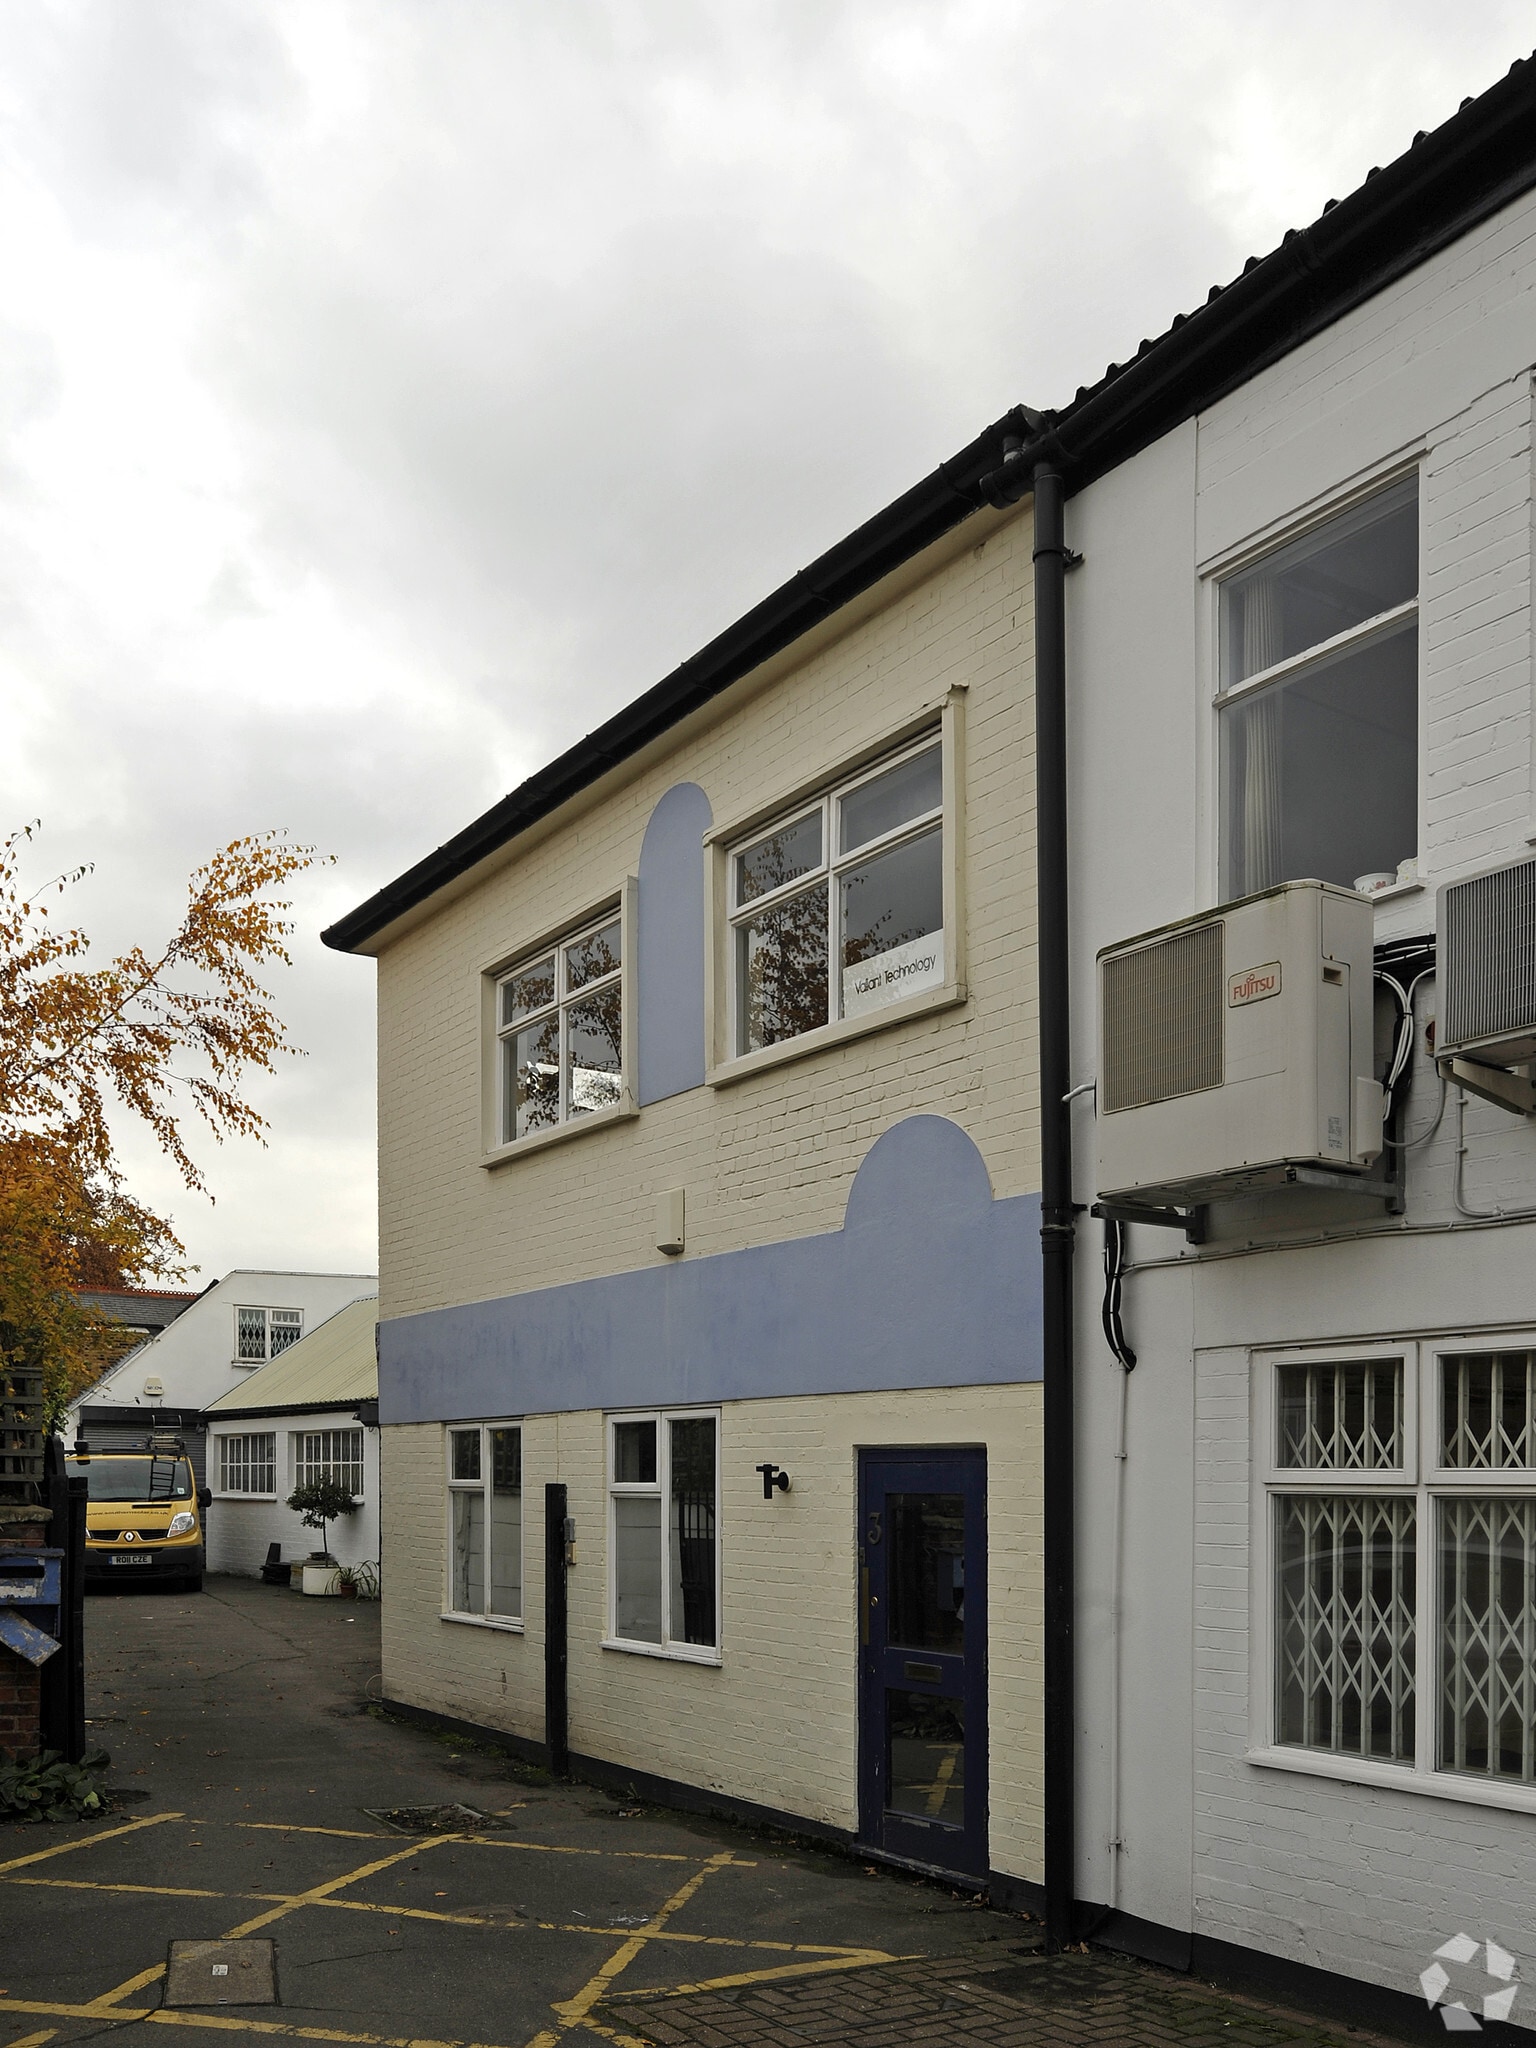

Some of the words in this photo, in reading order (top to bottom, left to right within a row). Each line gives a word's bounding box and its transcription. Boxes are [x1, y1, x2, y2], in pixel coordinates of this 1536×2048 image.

[855, 974, 882, 995] Valiant
[884, 955, 936, 985] Technology
[1233, 973, 1275, 1000] FUJITSU
[868, 1511, 882, 1545] 3
